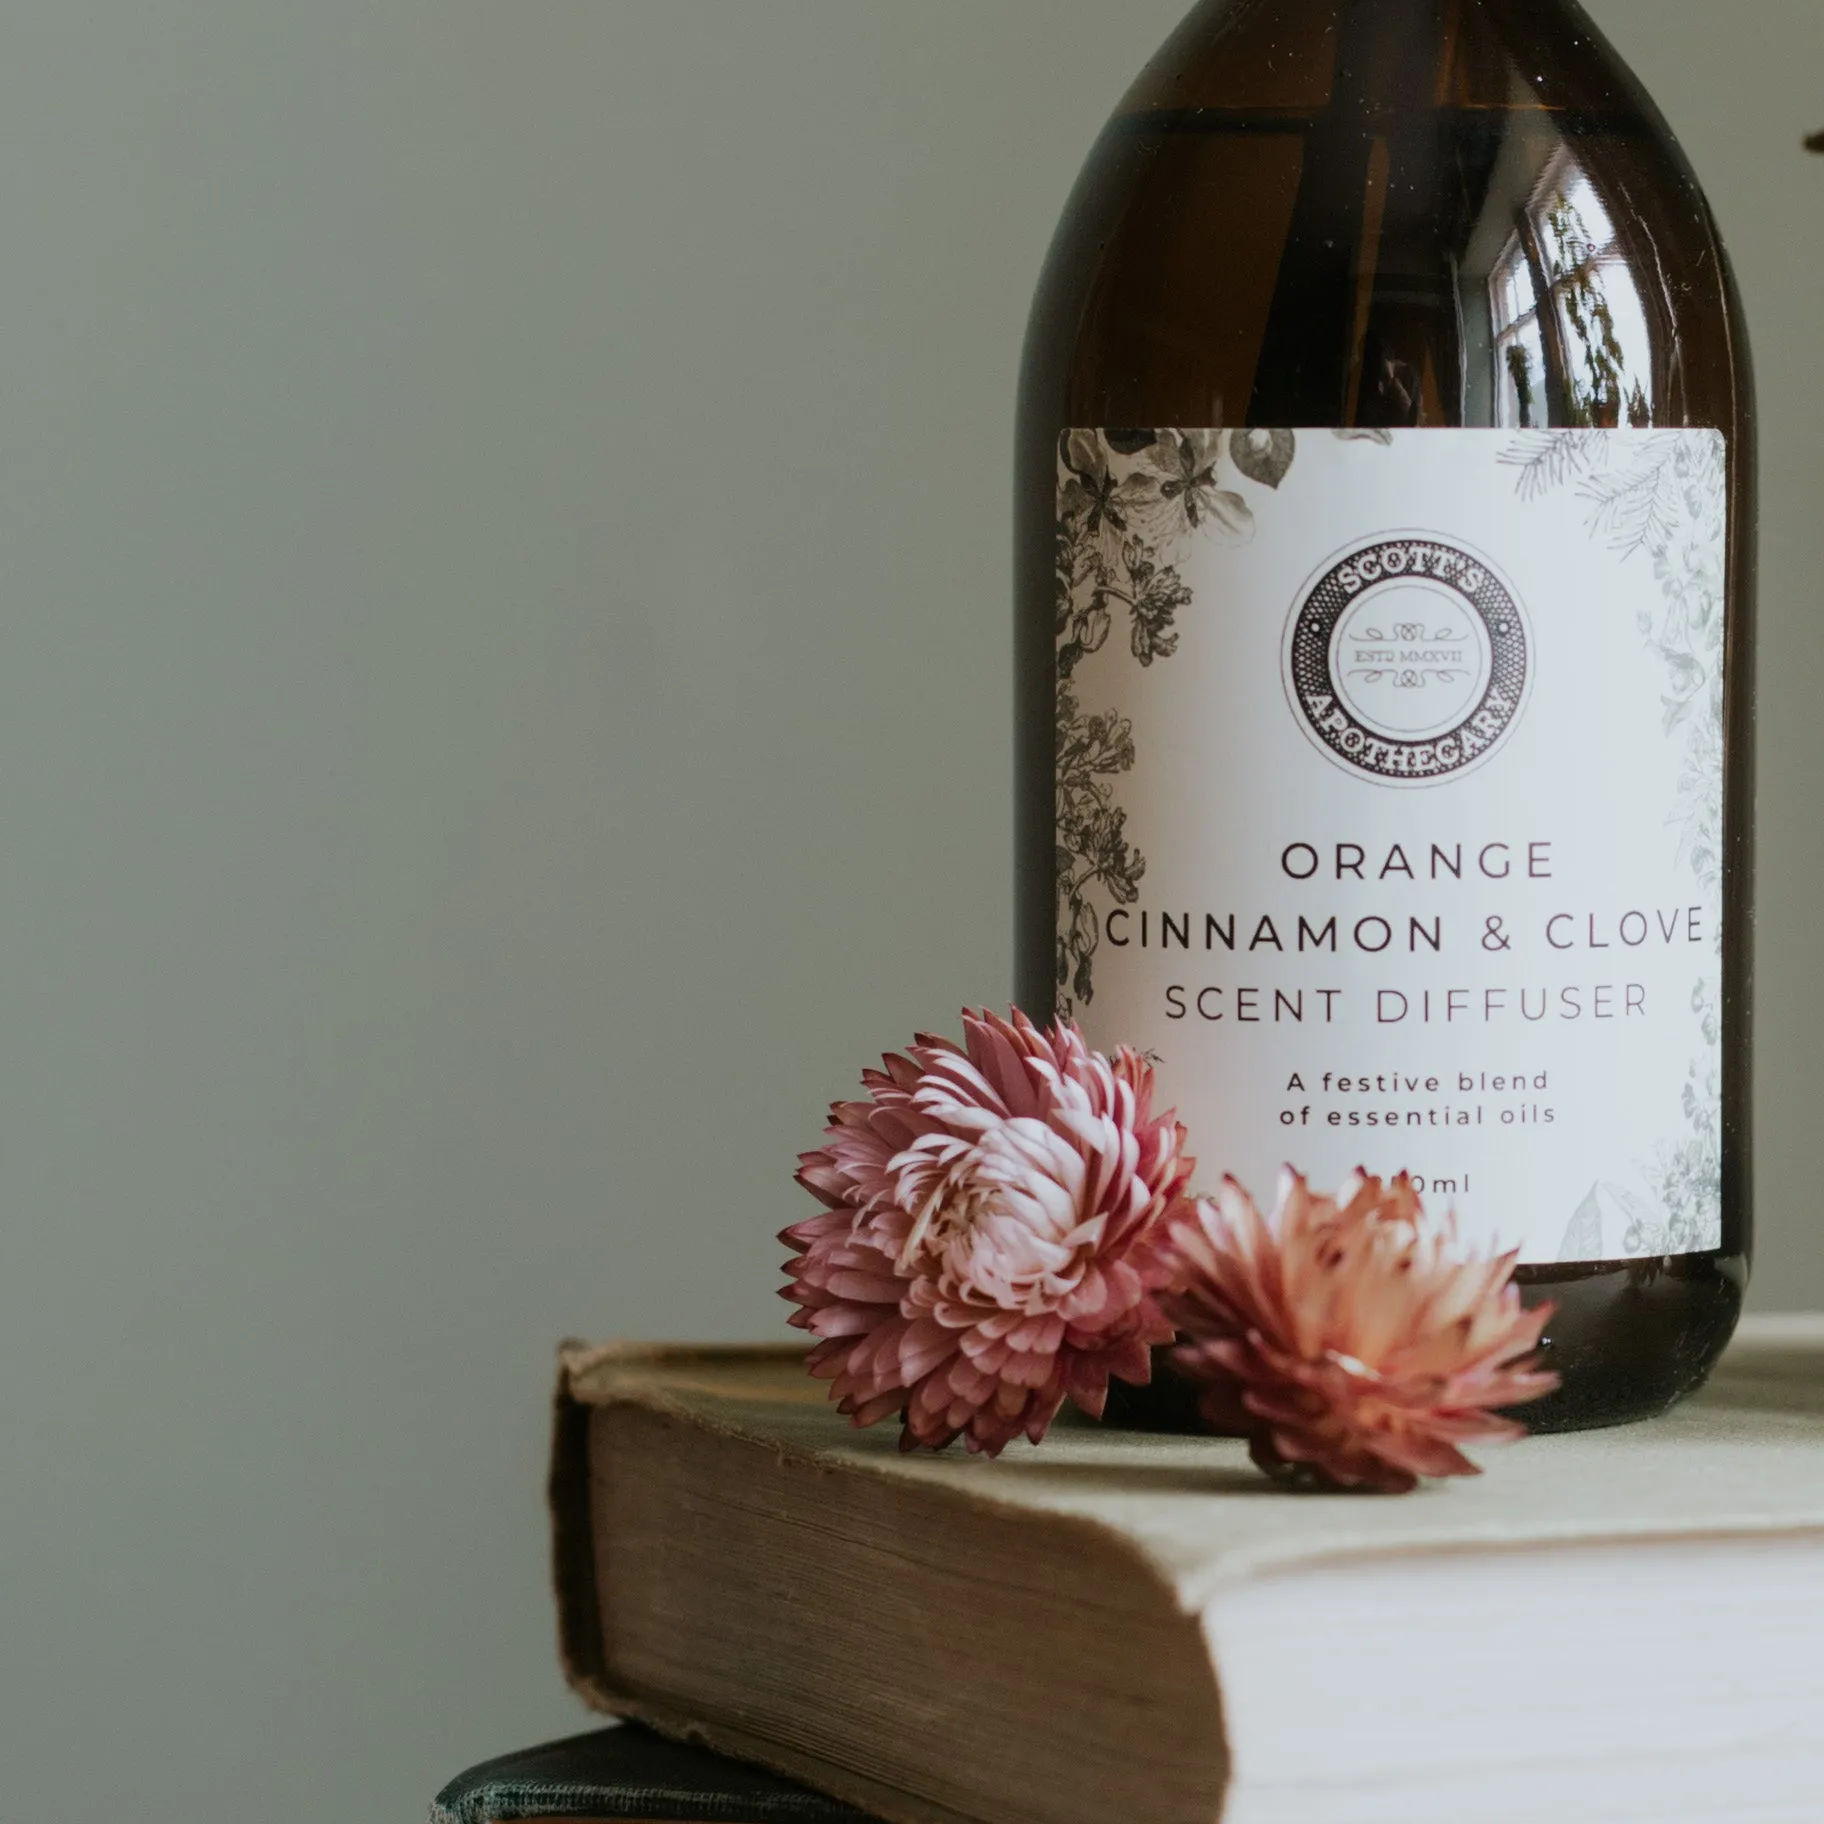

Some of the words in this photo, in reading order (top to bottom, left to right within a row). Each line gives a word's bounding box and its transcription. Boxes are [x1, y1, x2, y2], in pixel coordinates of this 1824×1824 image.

[1338, 546, 1485, 594] SCOTT'S
[1400, 650, 1463, 663] MMXVII
[1306, 686, 1512, 772] APOTHECARY
[1281, 842, 1552, 880] ORANGE
[1105, 908, 1441, 952] CINNAMON
[1481, 915, 1511, 951] &
[1546, 906, 1703, 950] CLOVE
[1165, 984, 1342, 1022] SCENT
[1377, 983, 1646, 1023] DIFFUSER
[1286, 1072, 1306, 1092] A
[1322, 1072, 1440, 1092] festive
[1458, 1070, 1548, 1092] blend
[1279, 1105, 1311, 1126] of
[1327, 1105, 1483, 1127] essential
[1500, 1104, 1555, 1125] oils
